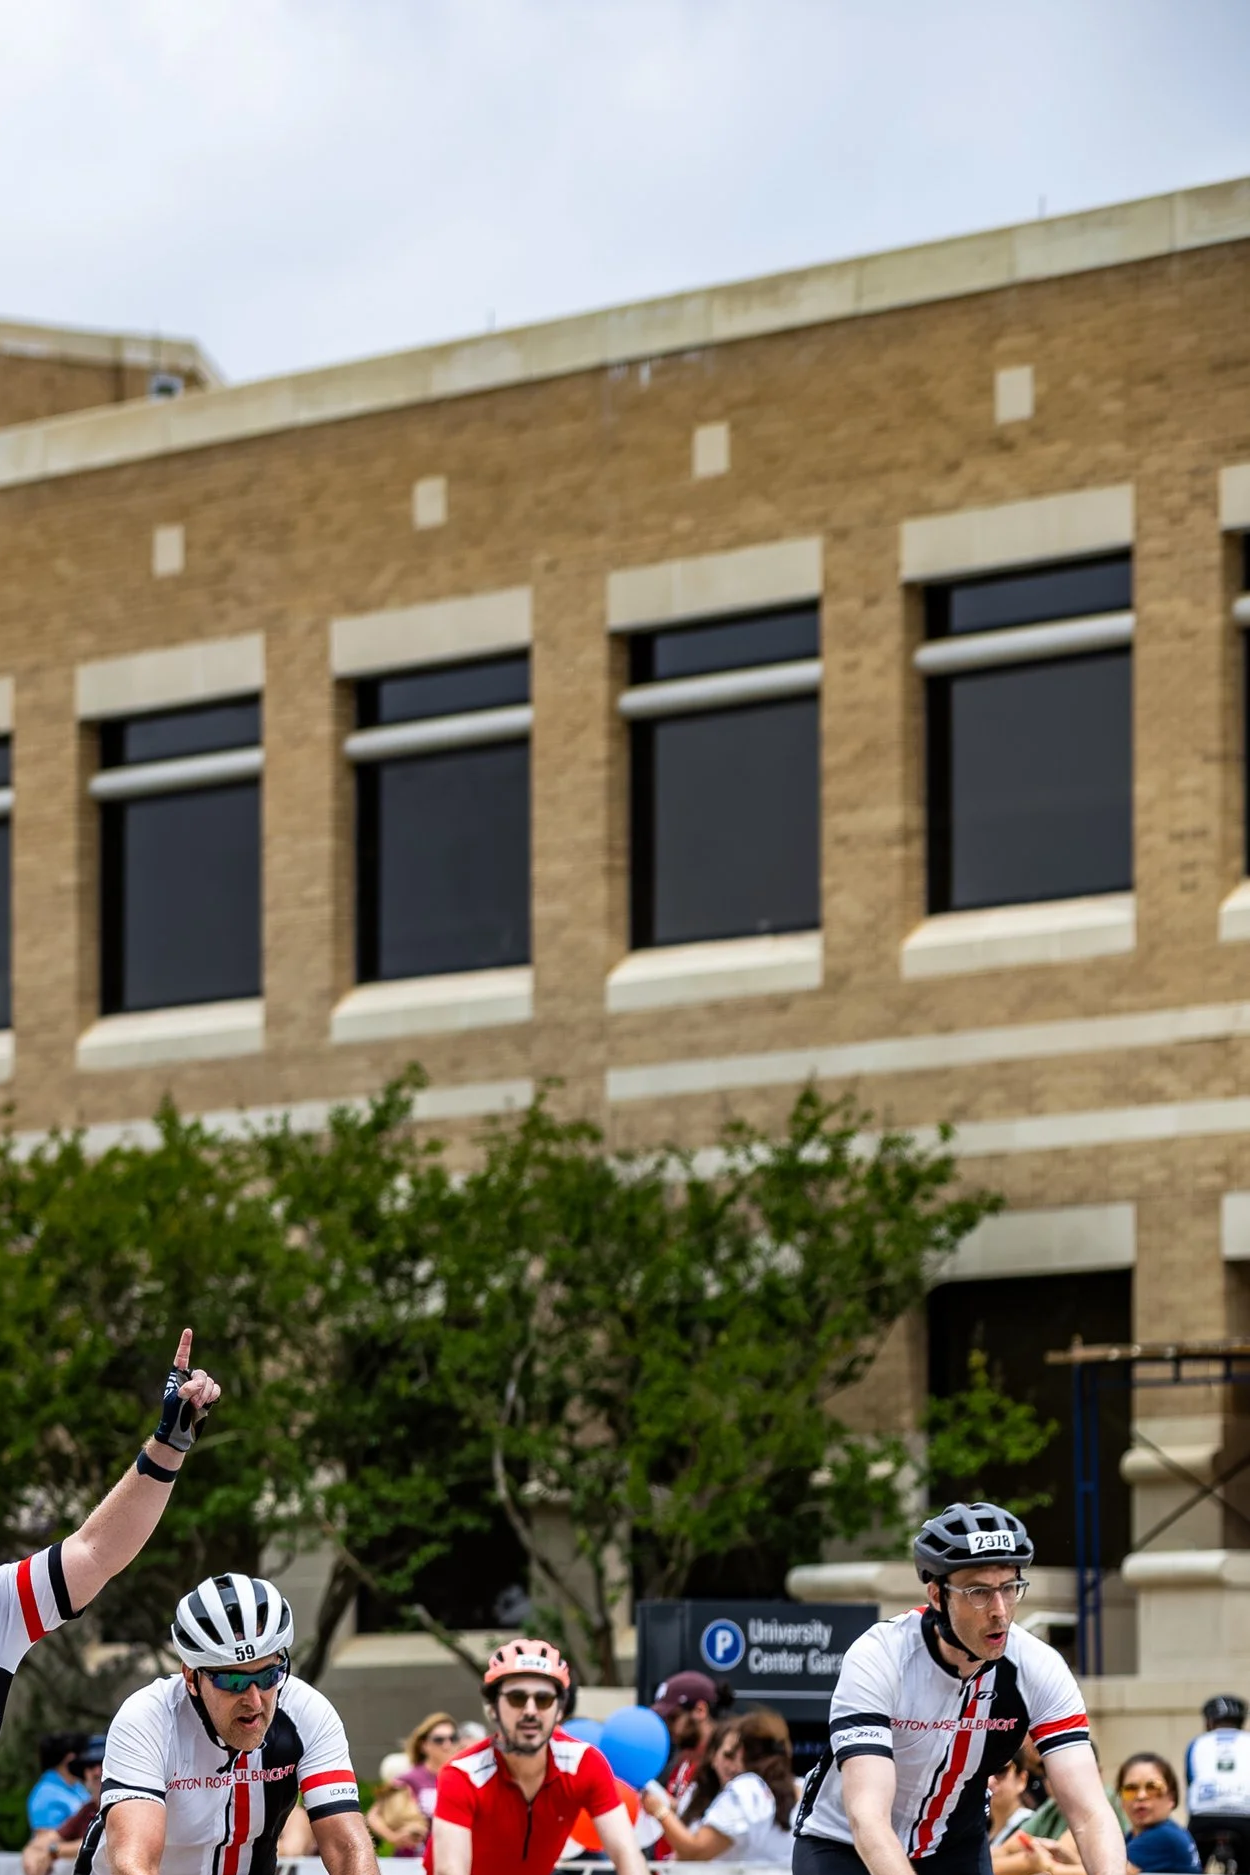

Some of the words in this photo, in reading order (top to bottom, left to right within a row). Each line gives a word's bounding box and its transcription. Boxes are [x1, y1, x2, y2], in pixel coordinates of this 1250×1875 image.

[748, 1619, 832, 1649] University
[234, 1644, 256, 1662] 59
[748, 1648, 804, 1675] Center
[205, 1775, 232, 1790] ROSE
